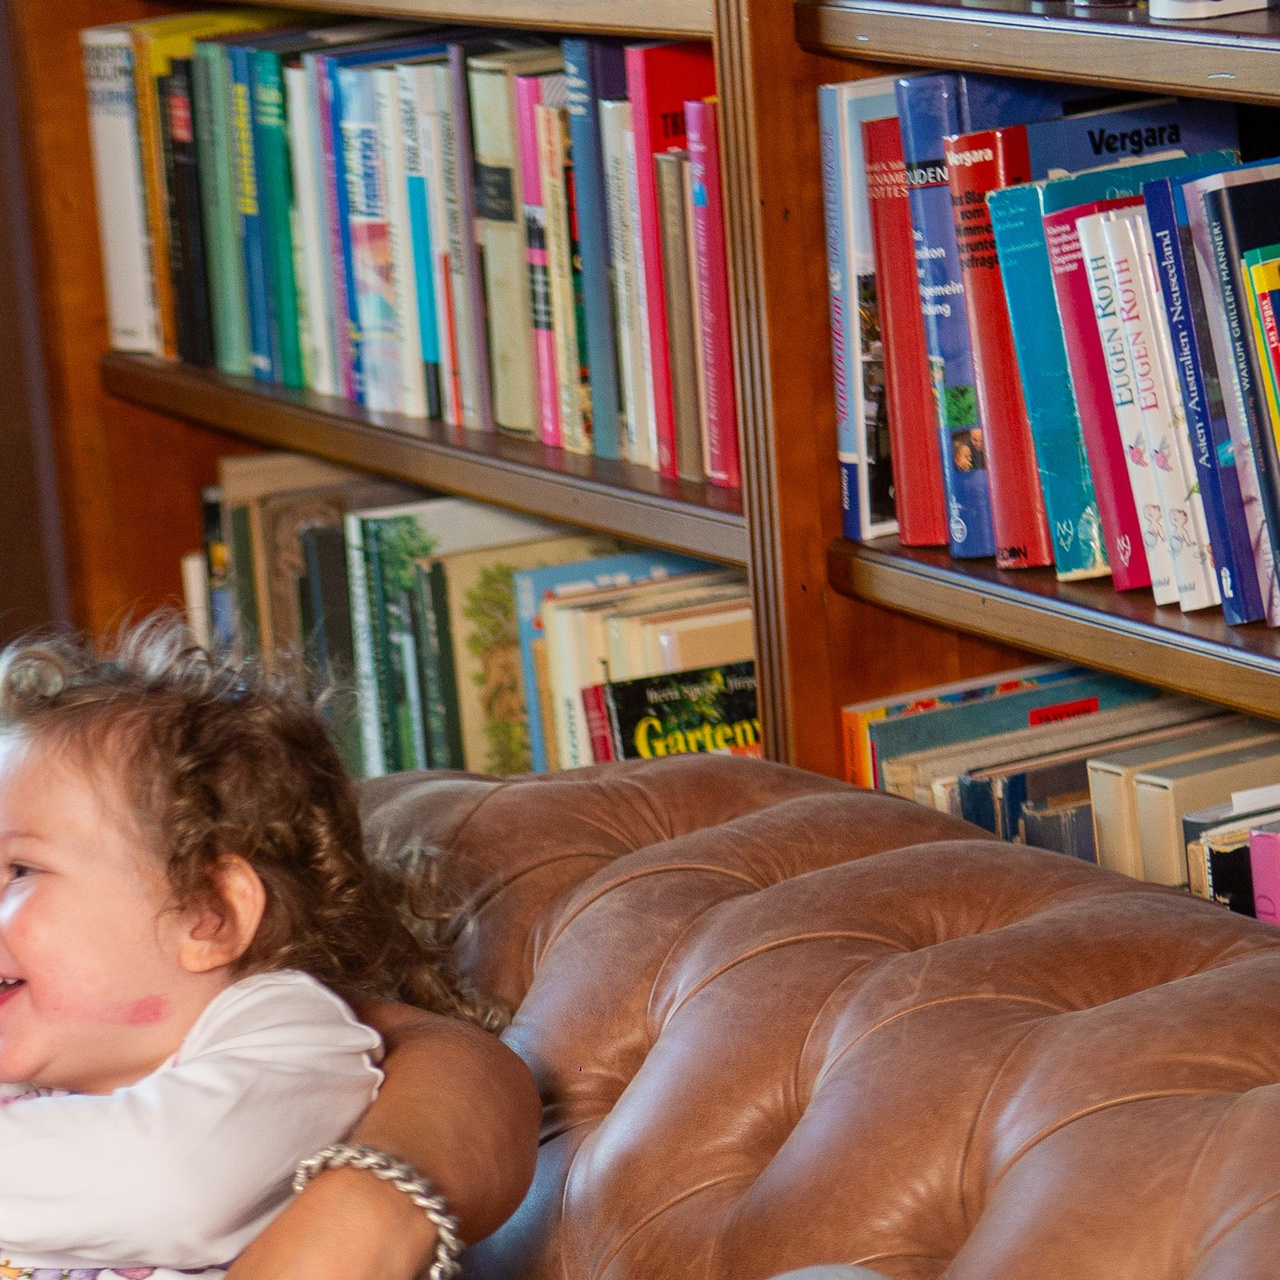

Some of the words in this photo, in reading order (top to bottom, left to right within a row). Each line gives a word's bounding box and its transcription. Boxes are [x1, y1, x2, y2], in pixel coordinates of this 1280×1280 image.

[946, 148, 994, 167] Vergara
[1088, 124, 1181, 156] Vergara
[821, 127, 841, 264] DACHTERRASSE
[829, 269, 842, 291] &
[1090, 255, 1117, 319] ROTH
[1115, 257, 1141, 323] ROTH
[1155, 229, 1185, 325] Neuseeland
[1224, 286, 1242, 339] GRILLEN
[1102, 328, 1135, 408] EUGEN
[1131, 331, 1160, 411] EUGEN
[1177, 330, 1201, 413] Australien
[1233, 350, 1251, 391] WARUM
[1194, 421, 1211, 468] Asien
